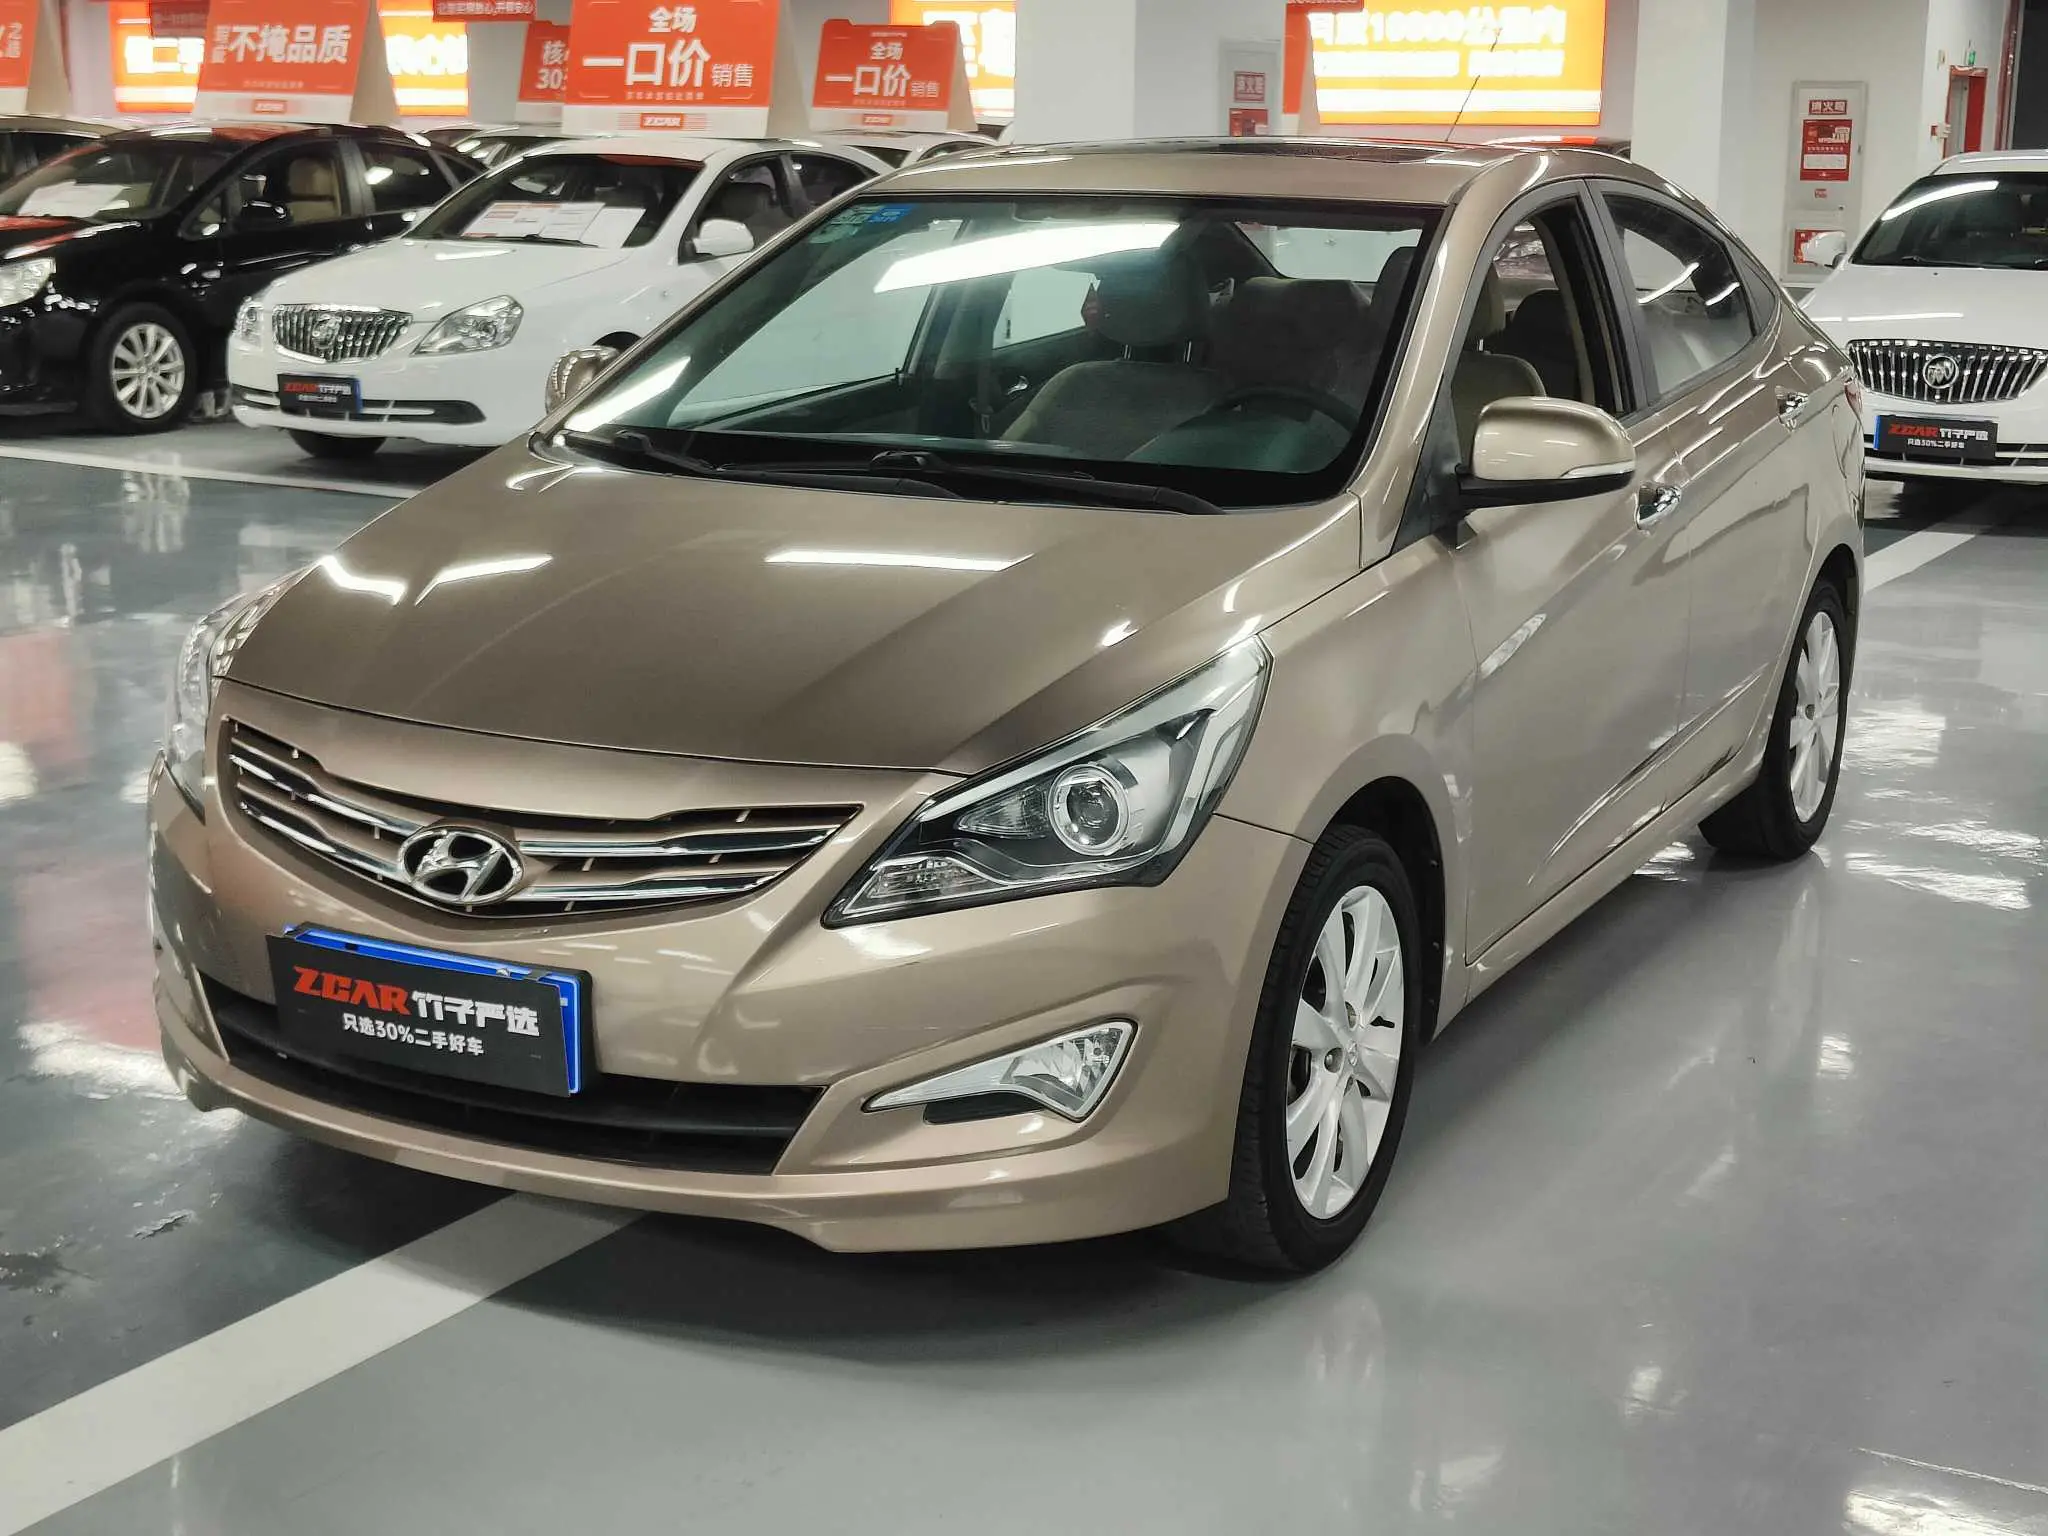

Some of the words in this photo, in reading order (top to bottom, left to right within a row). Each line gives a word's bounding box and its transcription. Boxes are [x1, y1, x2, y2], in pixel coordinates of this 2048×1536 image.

[648, 7, 697, 33] 全场
[229, 24, 351, 63] 不掩品质
[582, 39, 711, 87] 一口价
[712, 64, 753, 87] 销售
[870, 41, 904, 60] 全场
[825, 64, 911, 97] 一口价
[293, 966, 412, 1016] ZCAR
[411, 990, 540, 1036] 竹子严选
[342, 1012, 484, 1056] 只选30%二手好车
